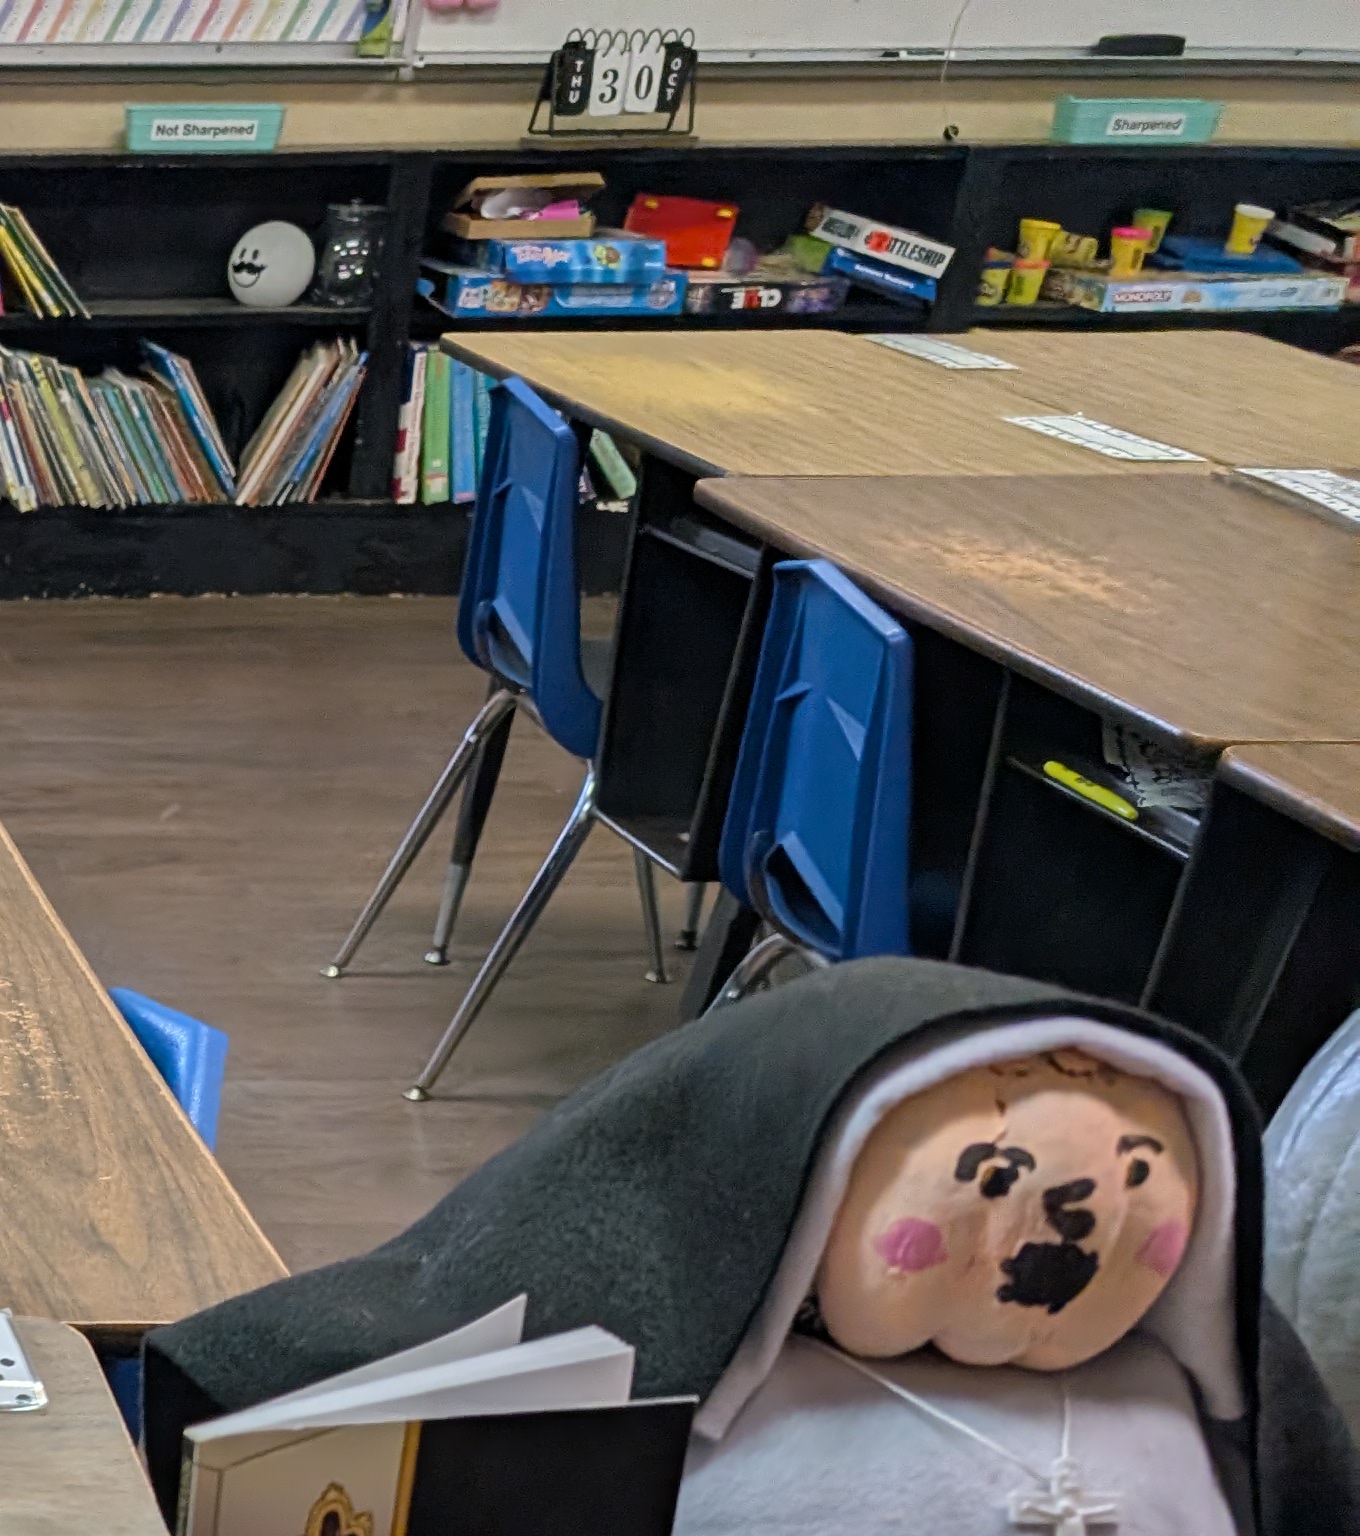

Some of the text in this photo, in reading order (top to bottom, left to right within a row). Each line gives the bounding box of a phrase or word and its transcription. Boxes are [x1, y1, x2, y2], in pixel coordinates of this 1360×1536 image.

[155, 123, 255, 138] Not Sharpened
[1112, 118, 1183, 134] Sharpened
